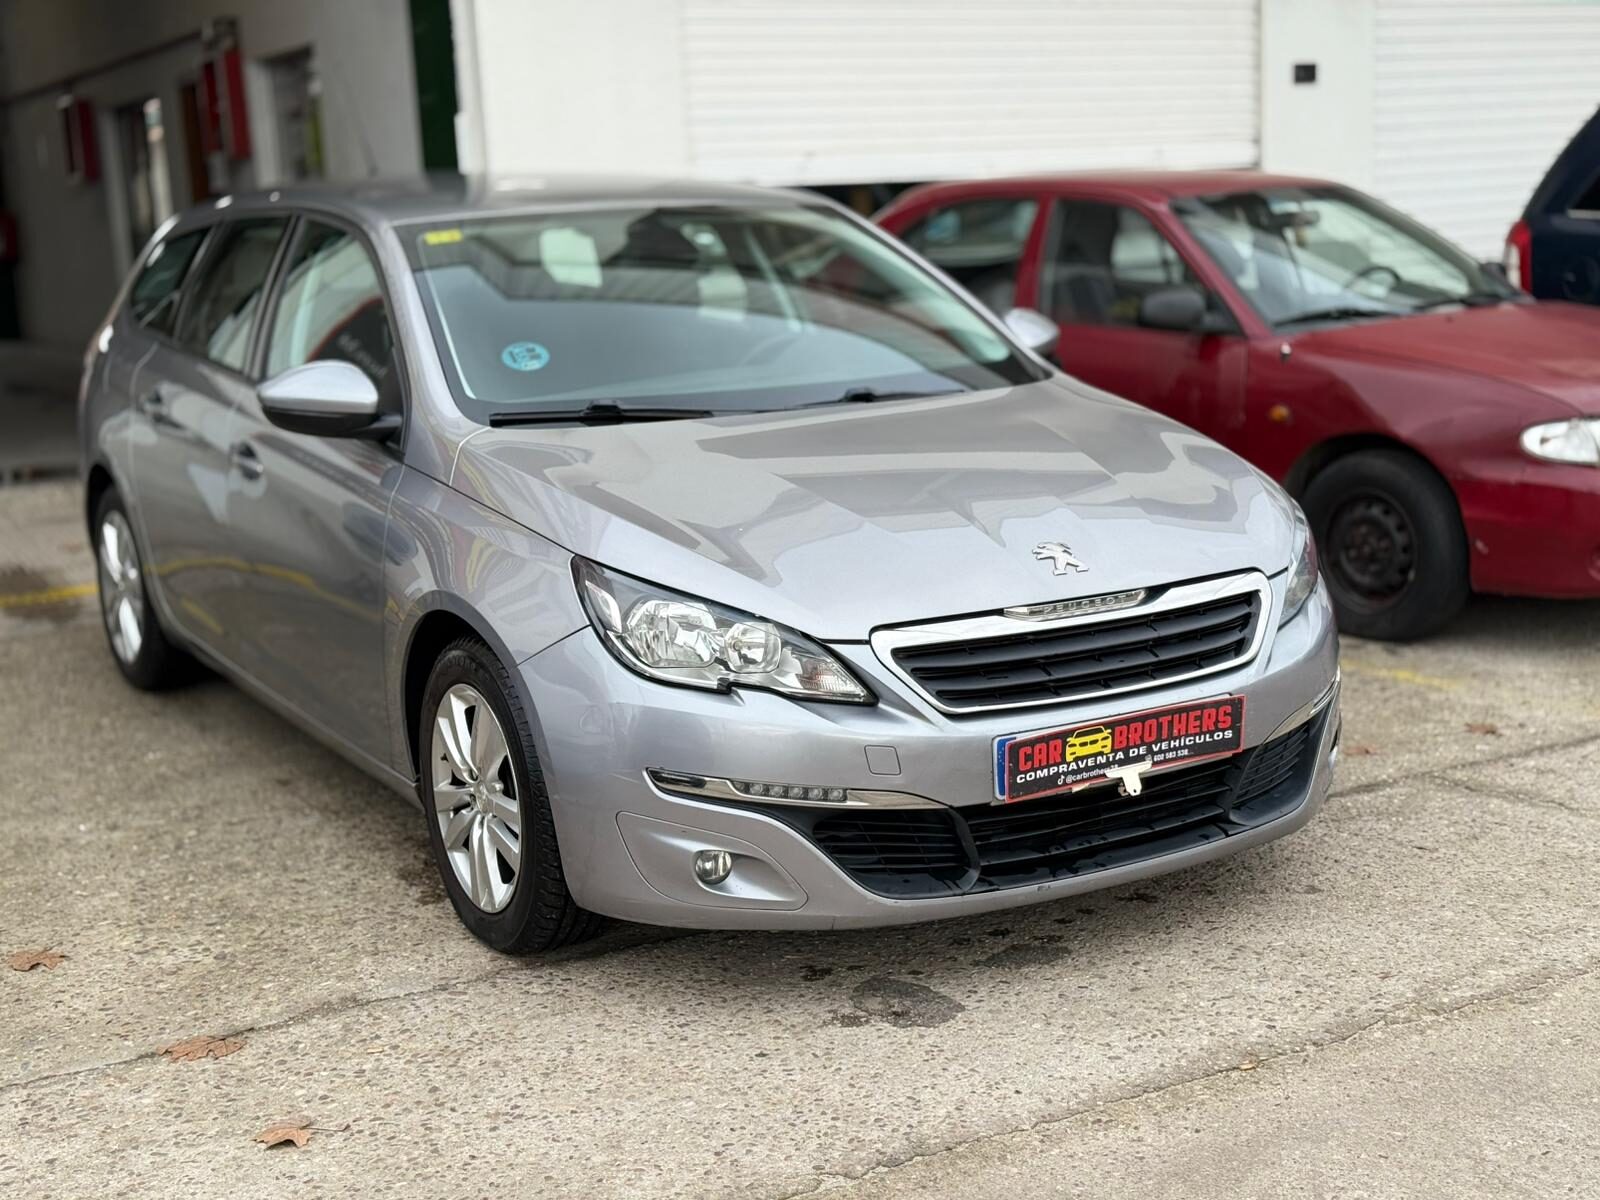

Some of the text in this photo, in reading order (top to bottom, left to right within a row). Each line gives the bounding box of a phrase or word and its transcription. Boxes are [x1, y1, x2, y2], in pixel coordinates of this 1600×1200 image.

[1043, 595, 1126, 614] PEUGEOT
[1016, 730, 1233, 784] COMPRAVENTA DE VEHÍCULOS
[1018, 705, 1232, 771] CAR BROTHERS
